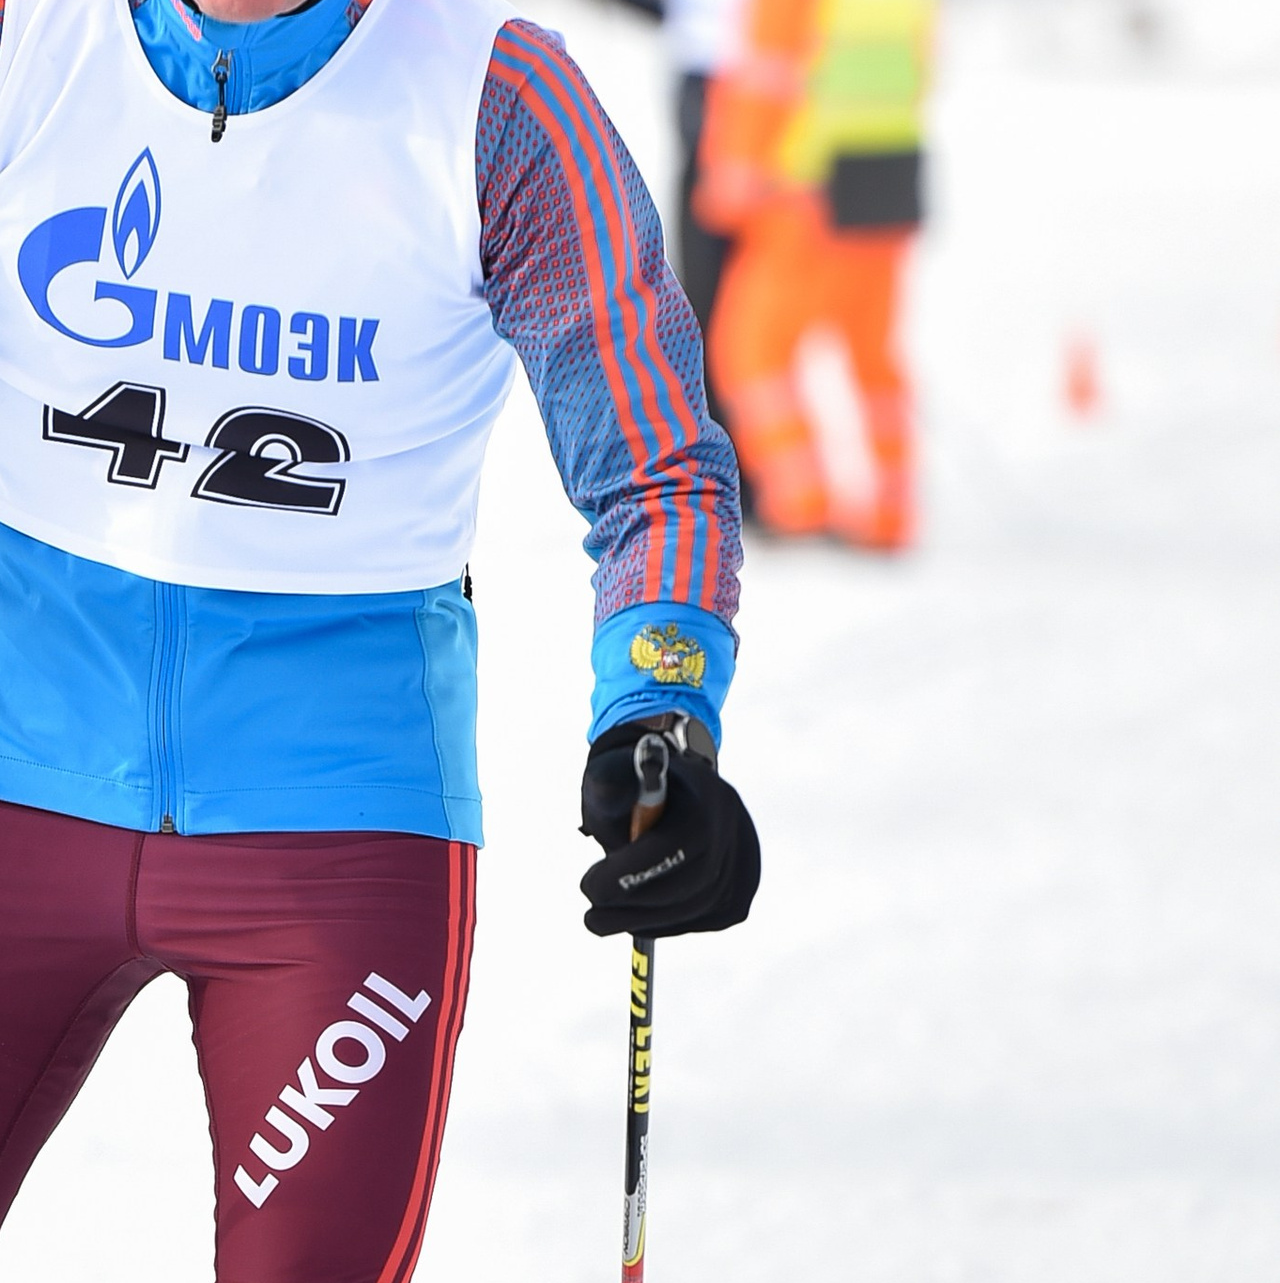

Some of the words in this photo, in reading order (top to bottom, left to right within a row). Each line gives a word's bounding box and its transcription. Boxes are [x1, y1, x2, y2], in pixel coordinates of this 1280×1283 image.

[163, 292, 380, 383] МОЭК
[42, 380, 351, 516] 42
[630, 947, 649, 1019] EKI
[233, 971, 432, 1209] LUKOIL
